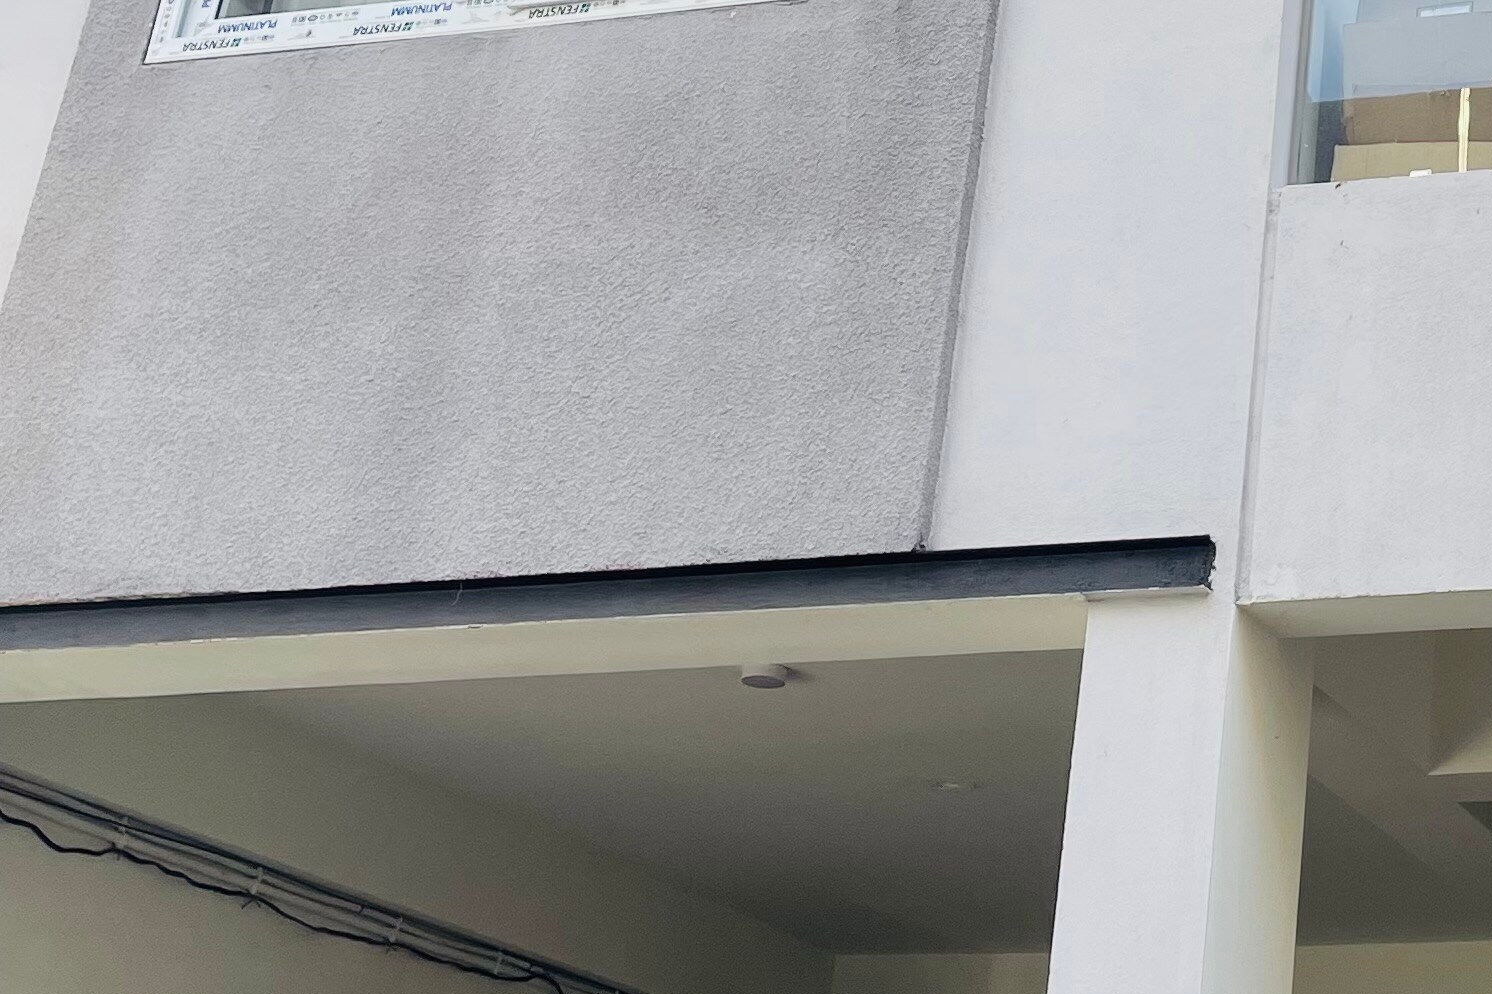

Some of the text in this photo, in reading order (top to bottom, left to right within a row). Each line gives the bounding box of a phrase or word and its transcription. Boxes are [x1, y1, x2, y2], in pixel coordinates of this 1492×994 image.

[528, 5, 580, 19] FENSTRA
[352, 22, 402, 36] FENSTRA
[182, 37, 231, 52] FENSTRA
